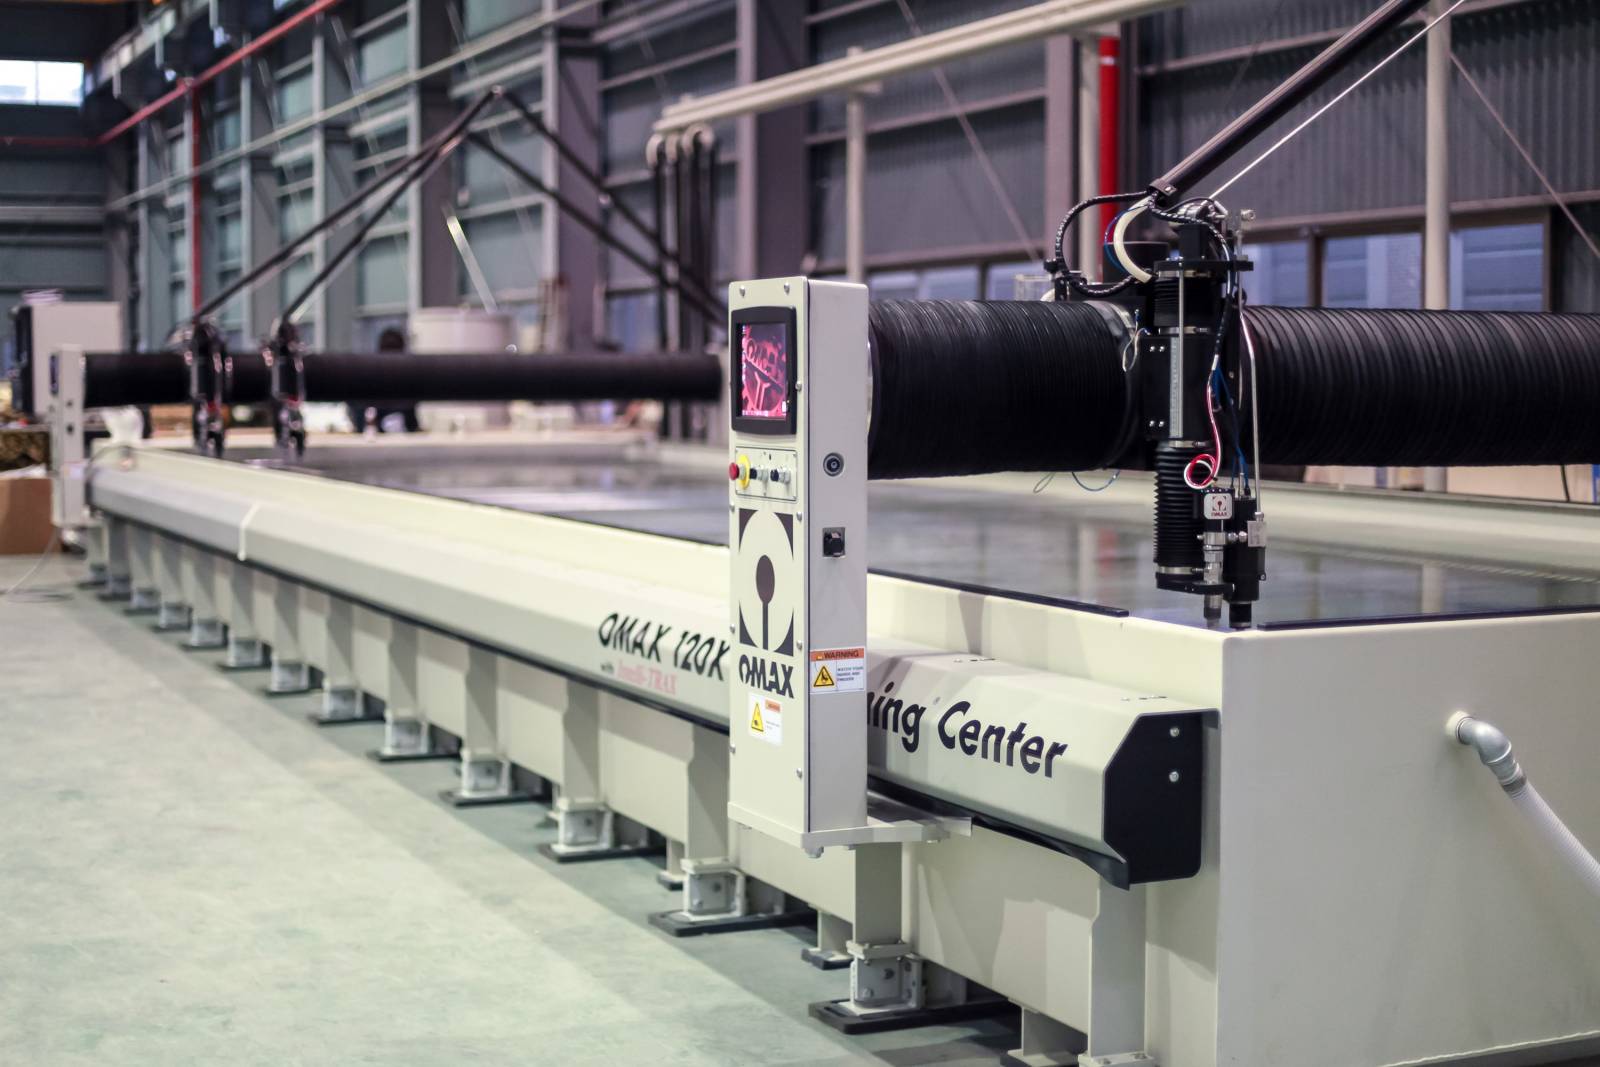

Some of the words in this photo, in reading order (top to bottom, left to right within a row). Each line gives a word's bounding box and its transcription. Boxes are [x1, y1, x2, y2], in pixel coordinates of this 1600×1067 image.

[598, 612, 672, 663] OMAX
[674, 630, 730, 681] 120X
[824, 650, 860, 659] WARNING
[739, 654, 794, 699] OMAX
[938, 701, 1068, 778] Center
